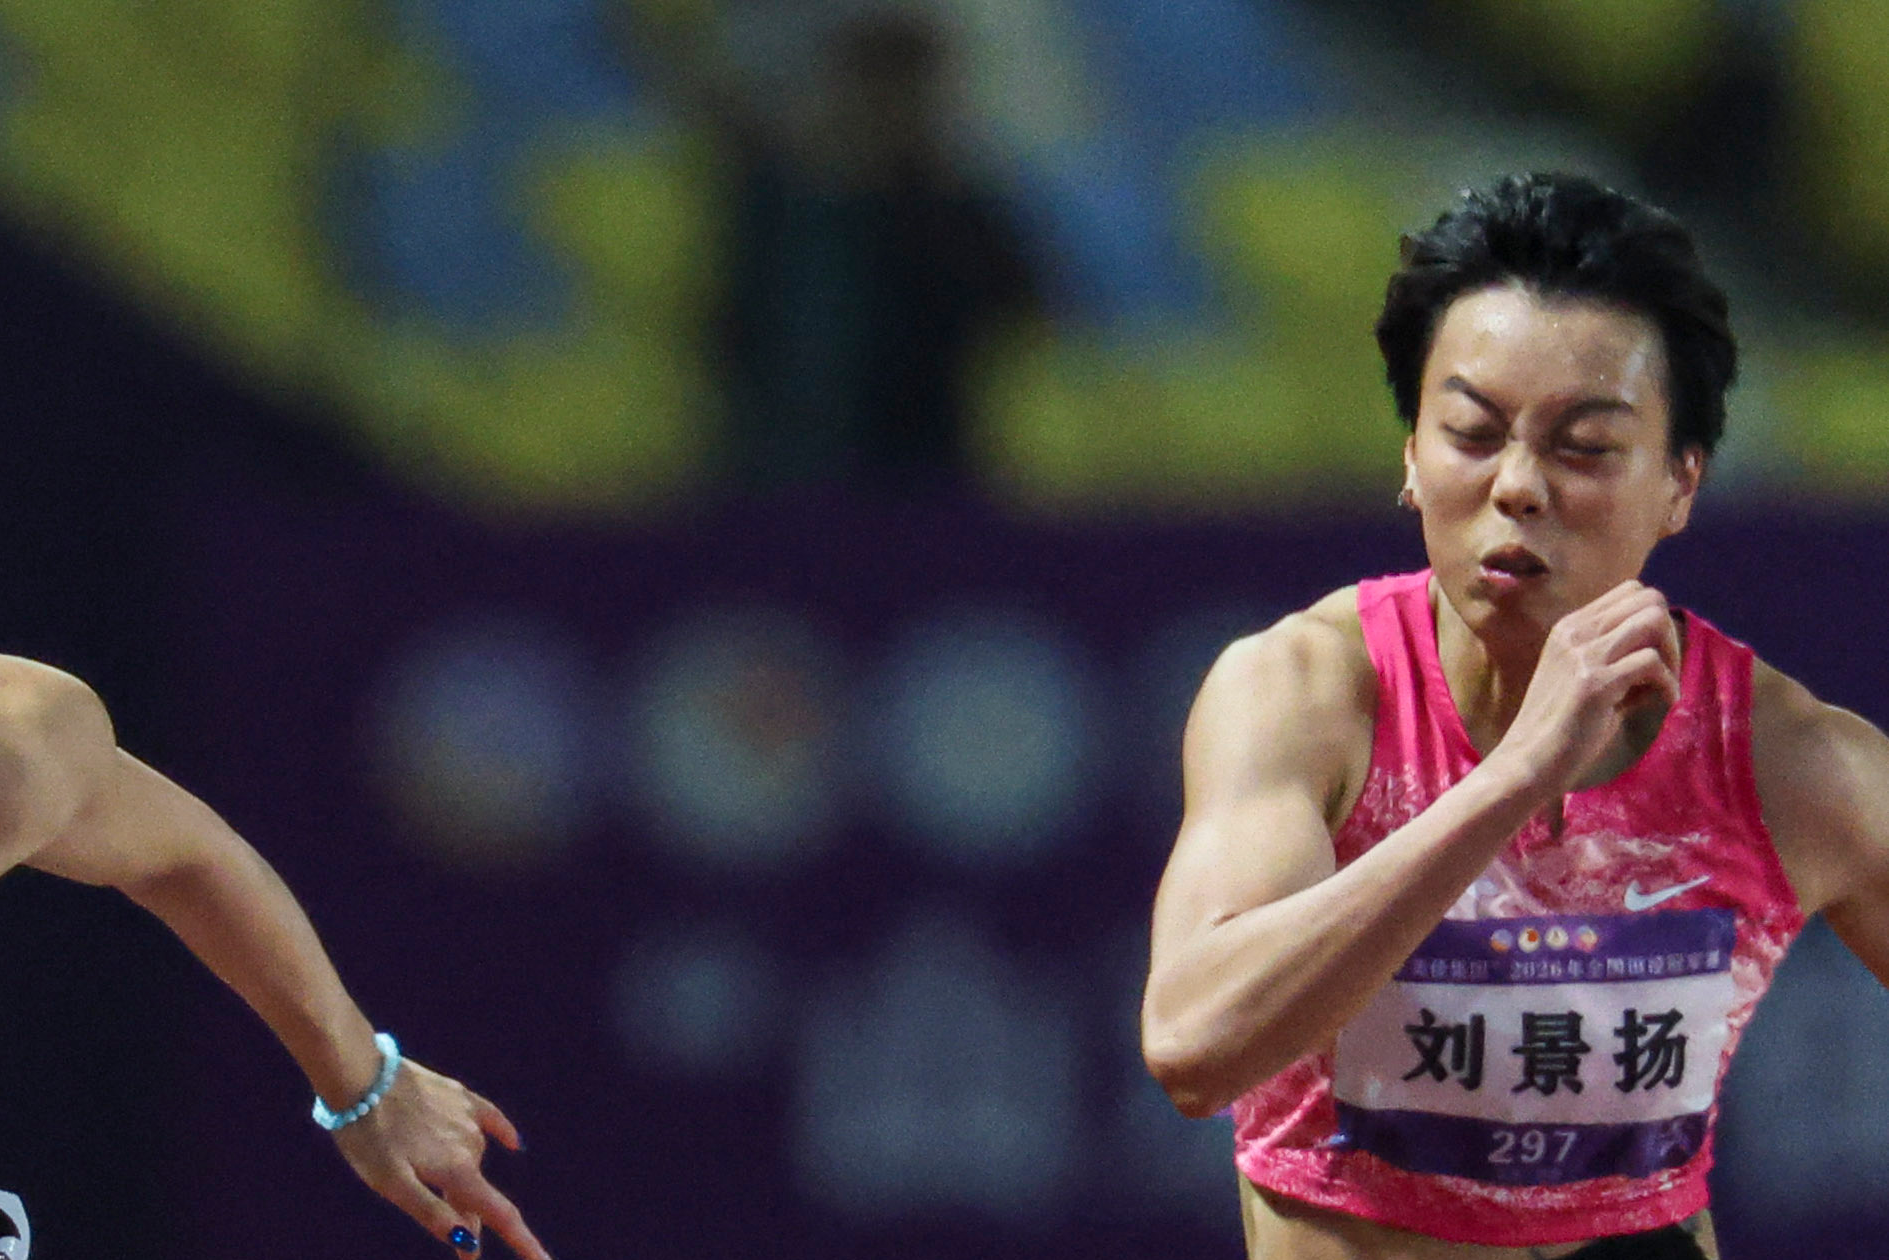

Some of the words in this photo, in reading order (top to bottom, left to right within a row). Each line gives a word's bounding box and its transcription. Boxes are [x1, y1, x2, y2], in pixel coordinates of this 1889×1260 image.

[1402, 1007, 1688, 1096] 刘景扬
[1487, 1130, 1578, 1164] 297
